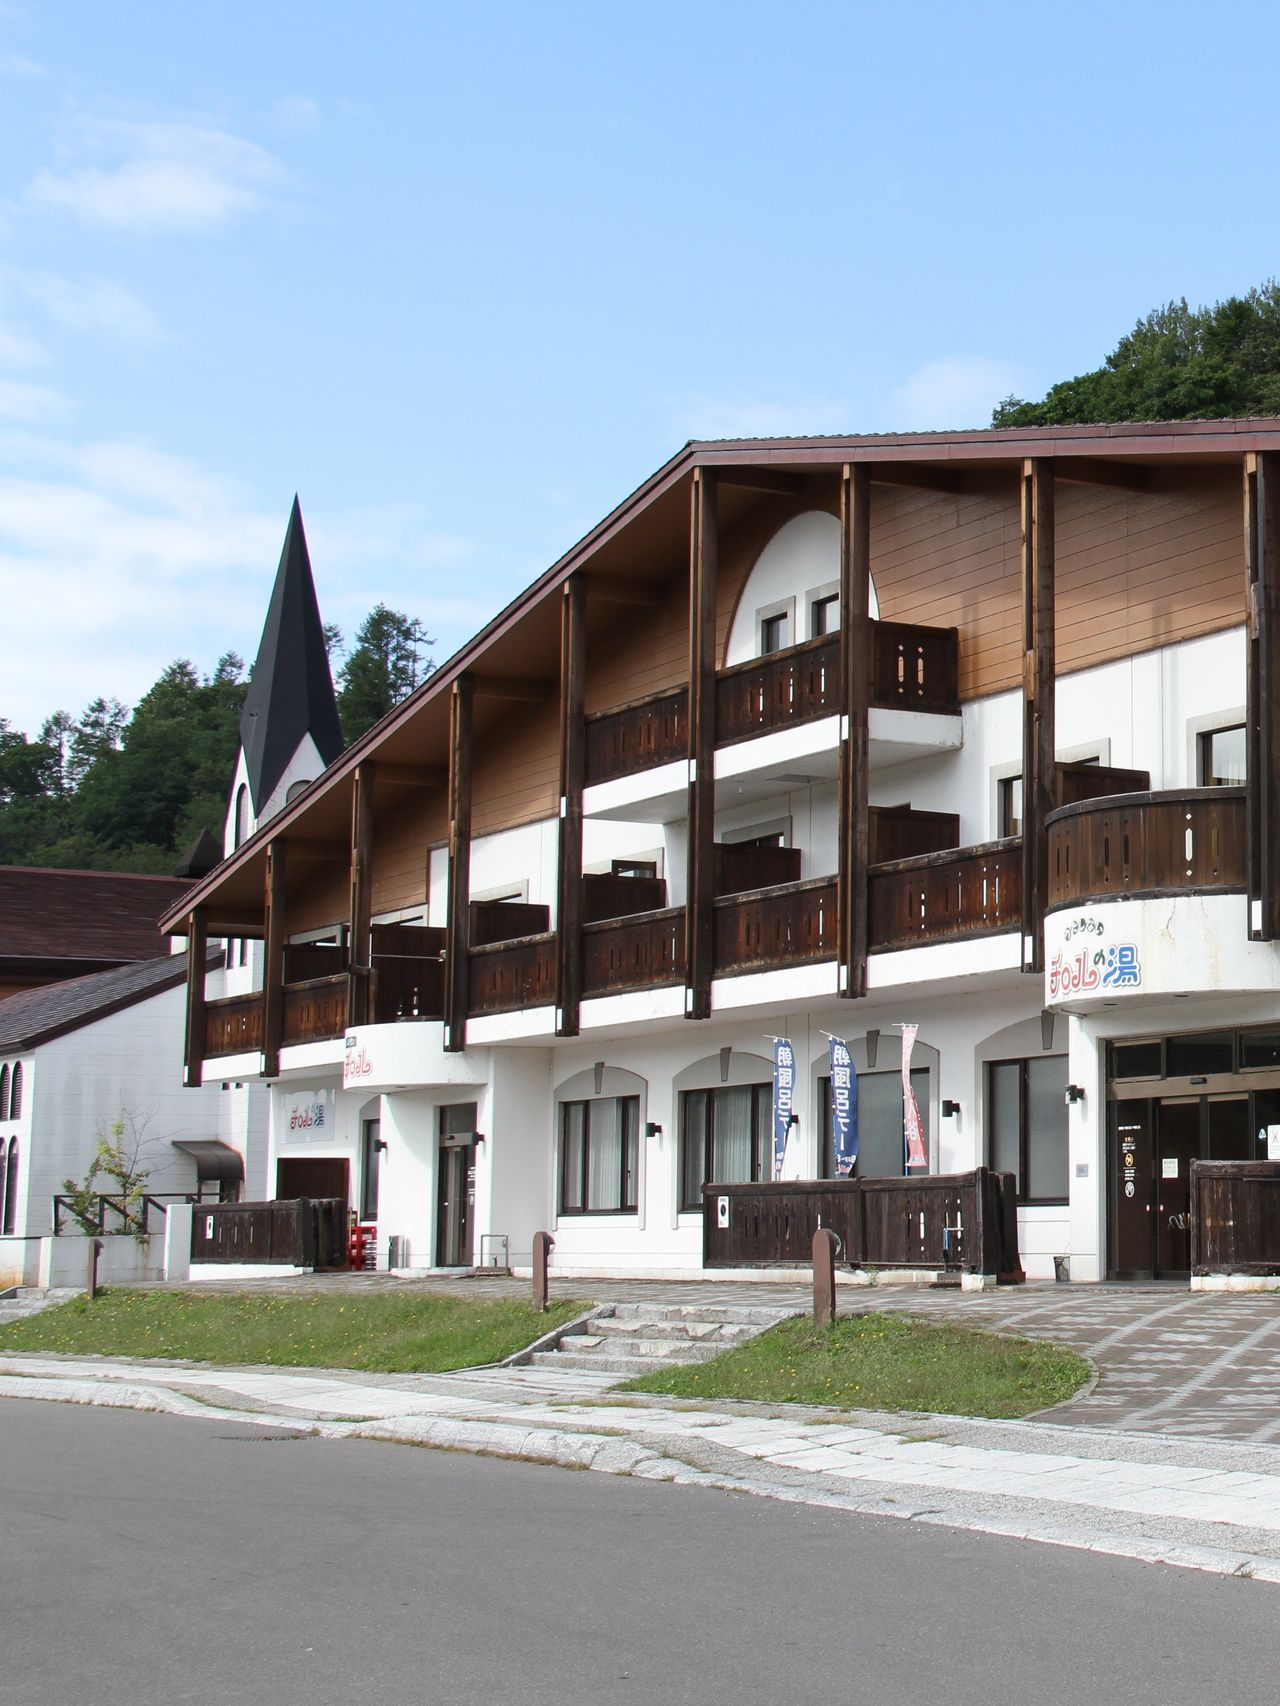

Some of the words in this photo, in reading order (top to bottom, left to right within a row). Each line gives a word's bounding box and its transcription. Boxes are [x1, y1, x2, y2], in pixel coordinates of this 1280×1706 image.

[1049, 944, 1140, 997] チロルの湯
